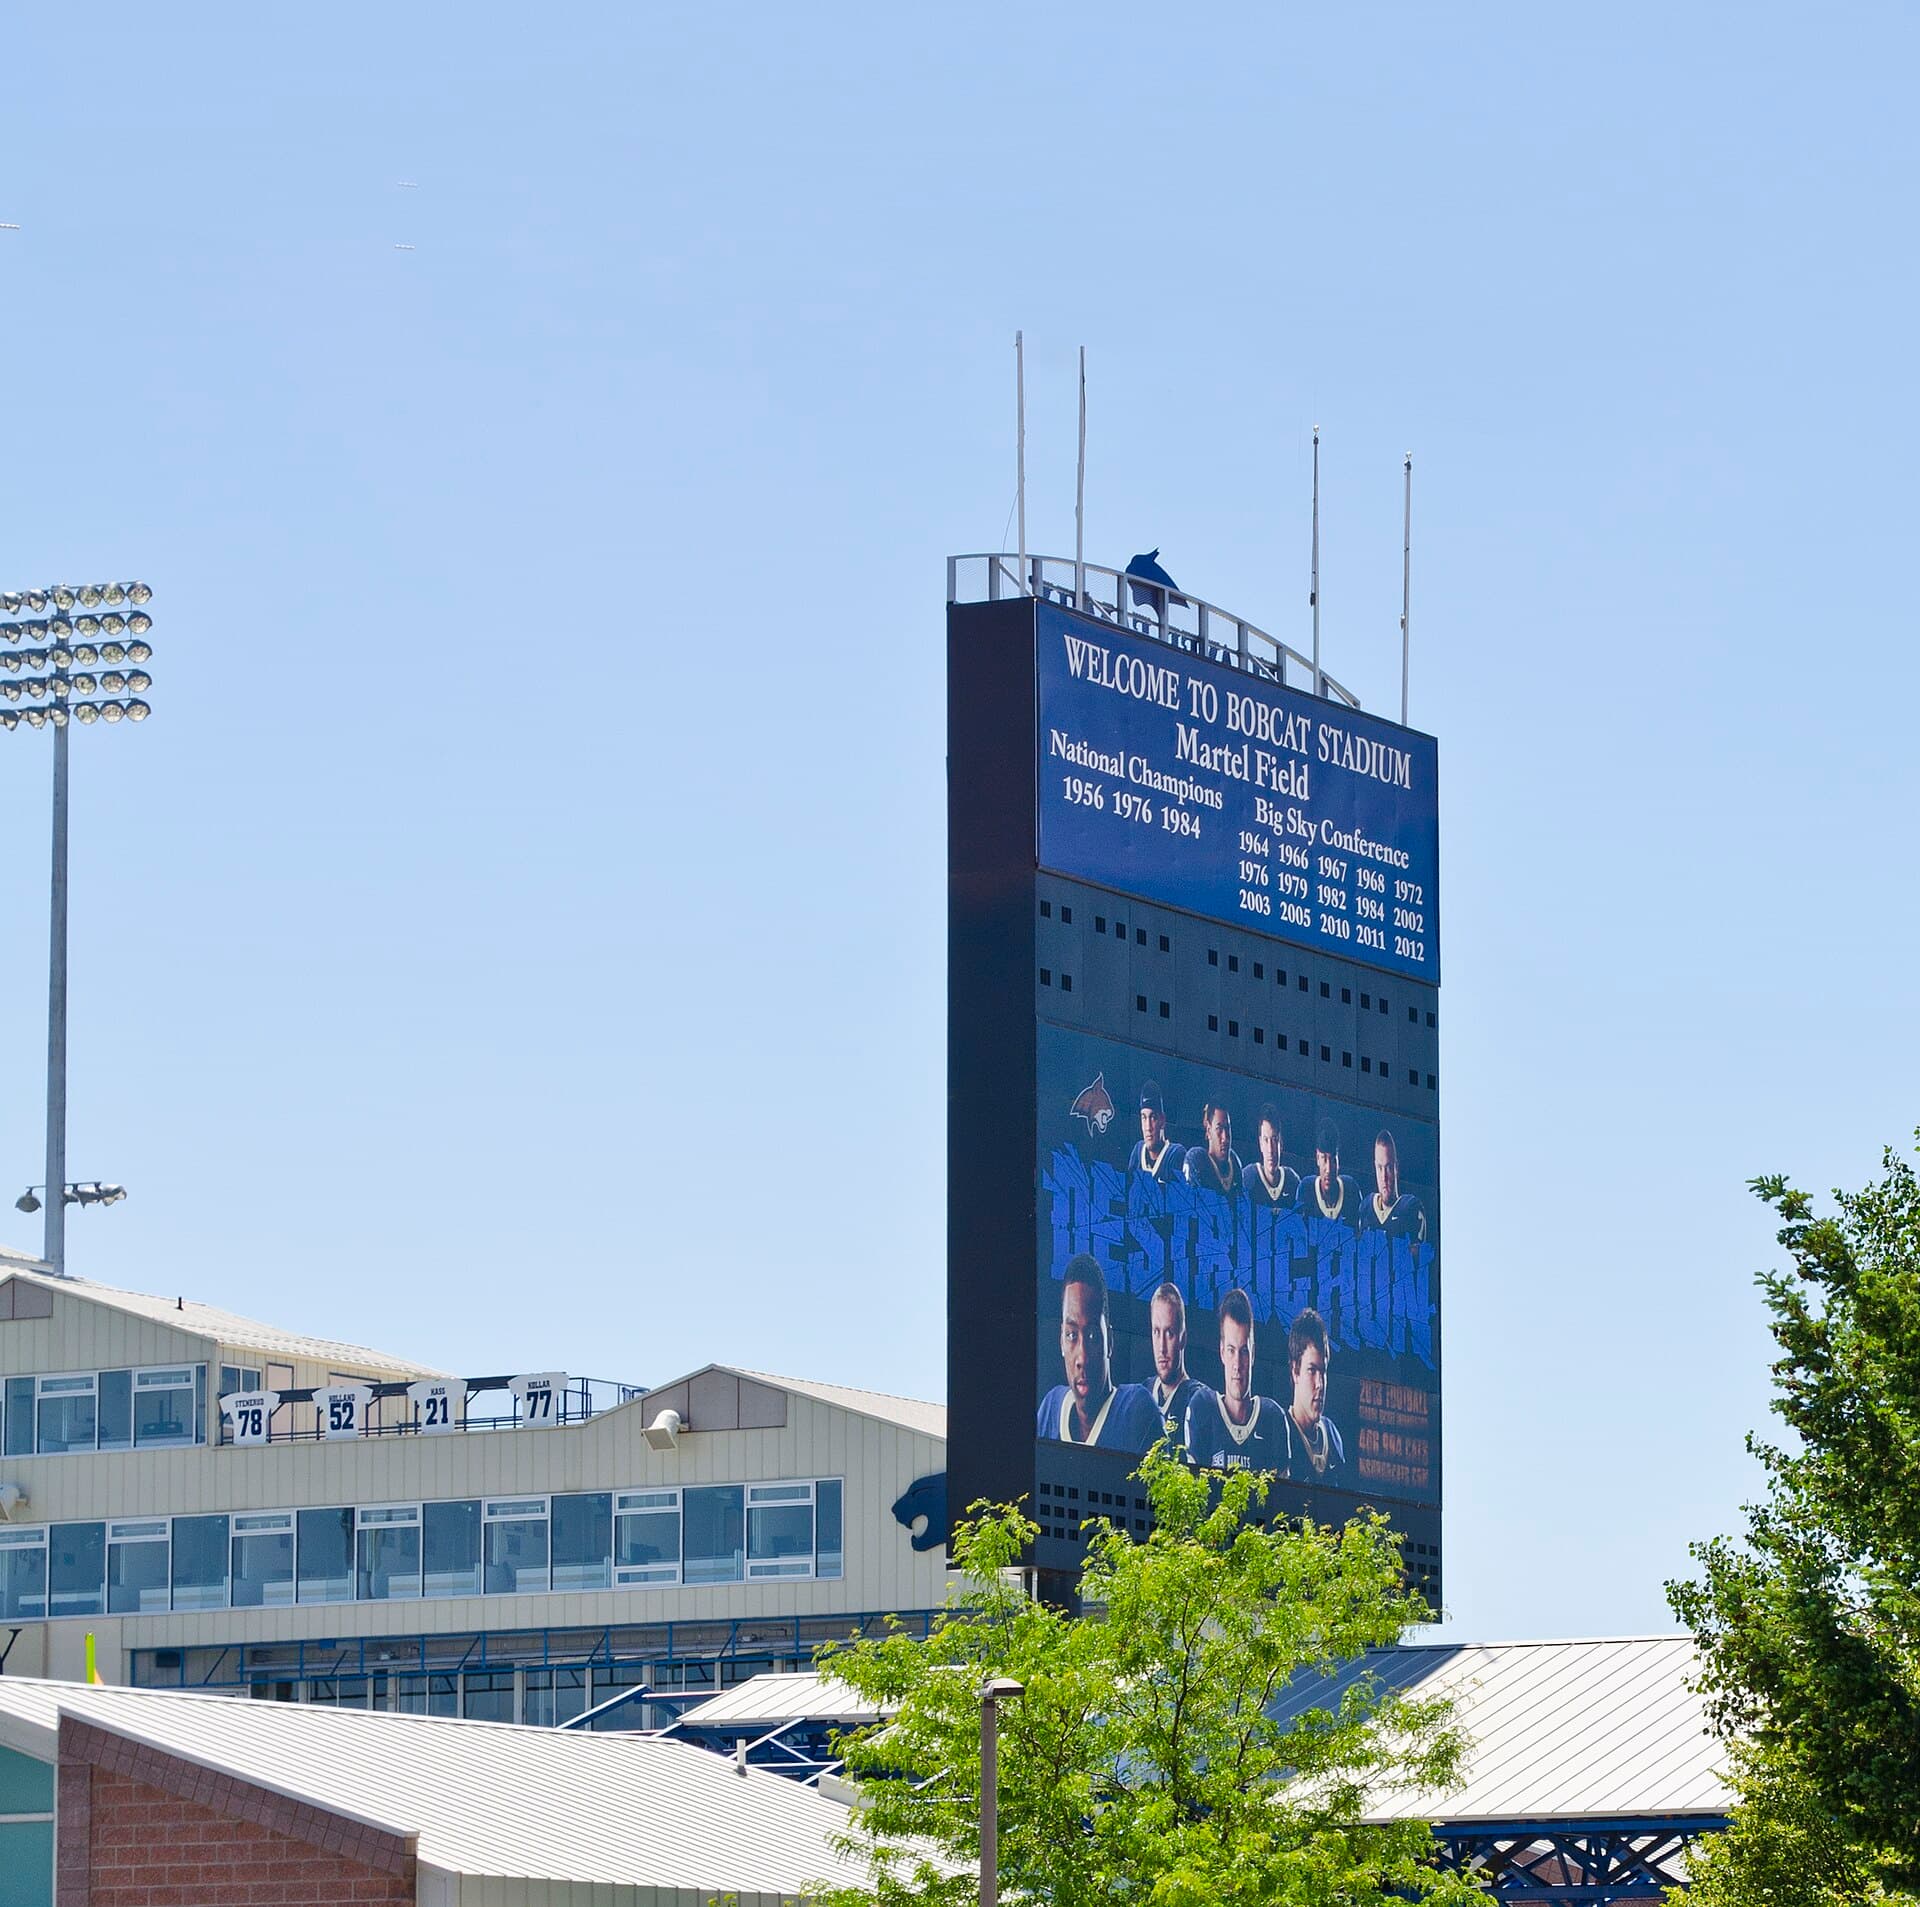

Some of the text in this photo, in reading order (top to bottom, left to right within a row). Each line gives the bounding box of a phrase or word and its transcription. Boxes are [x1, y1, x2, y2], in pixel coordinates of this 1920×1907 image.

[1064, 634, 1412, 790] WELCOME TO BOBCAT STADIUM
[1050, 728, 1223, 810] National Champions
[1175, 722, 1310, 802] Martel Field
[1063, 775, 1201, 840] 1956 1976 1984
[1254, 796, 1409, 869] Big Sky Conference
[1239, 831, 1423, 905] 1964 1966 1967 1968 1972
[1239, 860, 1424, 933] 1976 1979 1982 1984 2002
[1239, 888, 1425, 962] 2003 2005 2010 2011 2012
[1042, 1142, 1437, 1370] DESTRUCTION
[238, 1409, 262, 1437] 78
[330, 1402, 354, 1431] 52
[426, 1397, 448, 1425] 21
[526, 1390, 552, 1419] 77
